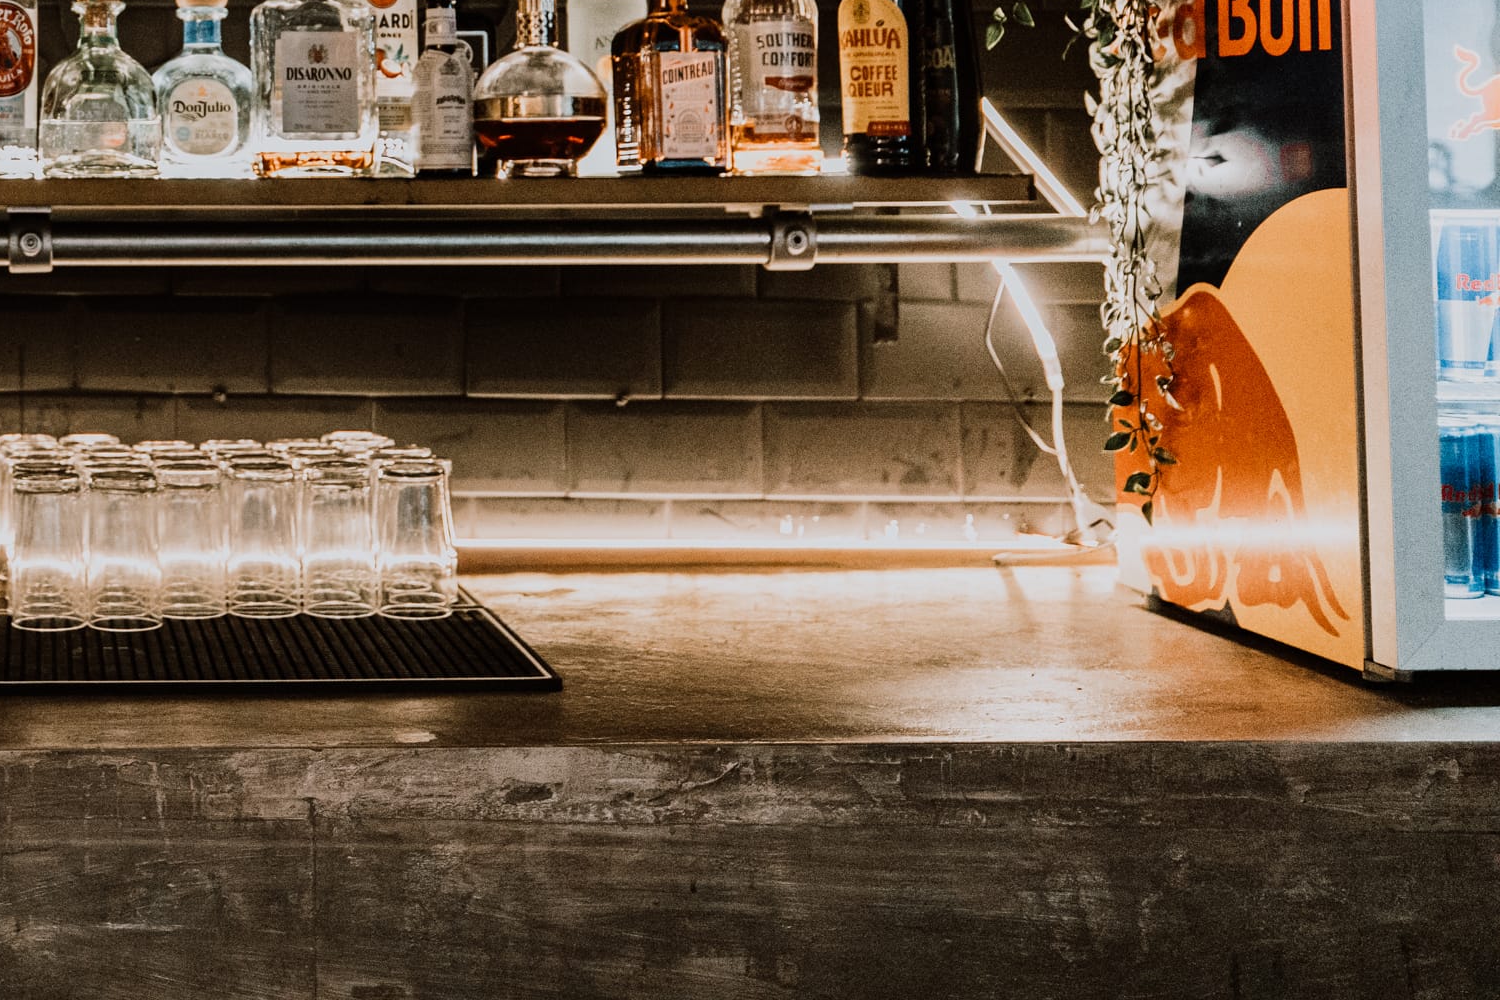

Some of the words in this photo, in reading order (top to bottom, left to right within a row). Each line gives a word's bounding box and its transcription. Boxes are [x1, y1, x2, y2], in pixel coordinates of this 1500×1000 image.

[756, 32, 814, 49] SOUTHER
[286, 67, 352, 81] DISARONNO
[662, 60, 713, 85] COINTREAU
[850, 65, 898, 81] COFFEE
[849, 82, 894, 97] QUEUR
